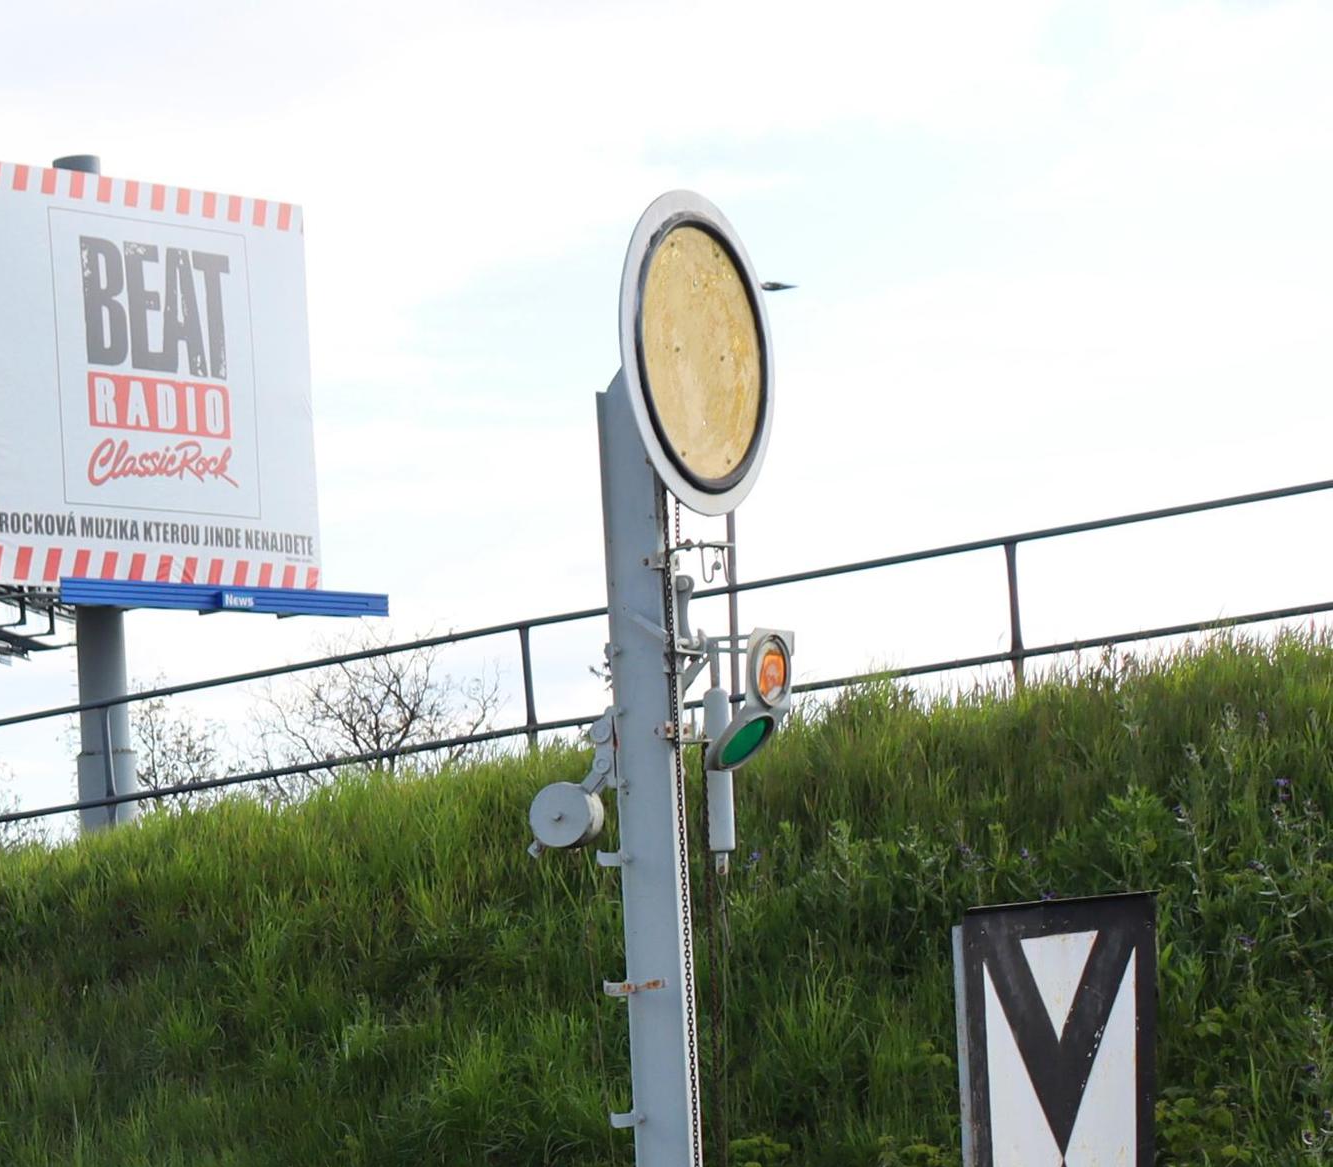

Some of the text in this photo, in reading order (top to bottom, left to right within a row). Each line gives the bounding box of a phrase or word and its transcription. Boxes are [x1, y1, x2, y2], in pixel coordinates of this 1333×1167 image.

[79, 235, 230, 380] BEAT
[94, 377, 225, 436] RADIO
[81, 516, 139, 542] MUZIKA
[143, 521, 200, 545] KTEROU
[203, 525, 241, 549] JINDE
[245, 529, 313, 556] NENAJDETE
